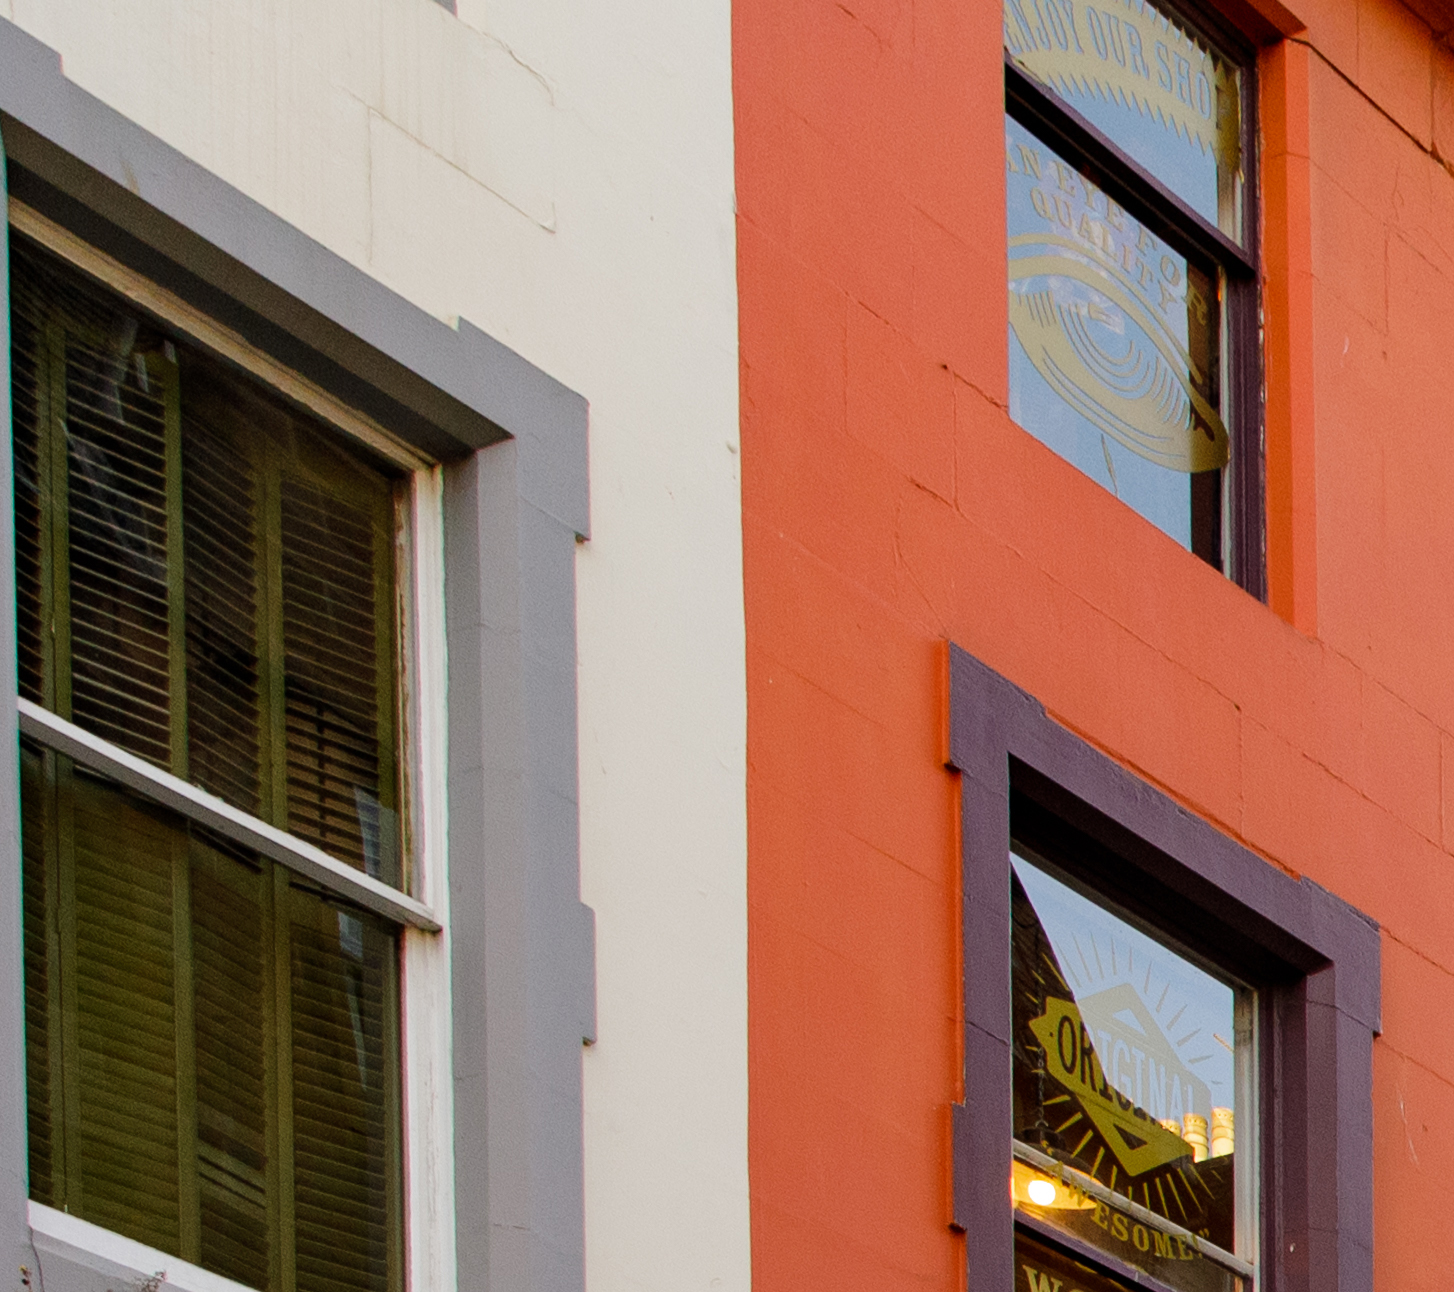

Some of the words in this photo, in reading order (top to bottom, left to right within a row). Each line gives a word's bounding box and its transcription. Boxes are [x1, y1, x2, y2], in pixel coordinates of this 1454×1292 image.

[1087, 6, 1149, 81] OUR
[1030, 187, 1177, 314] QUALITY
[1058, 1015, 1196, 1123] ORIGINAL
